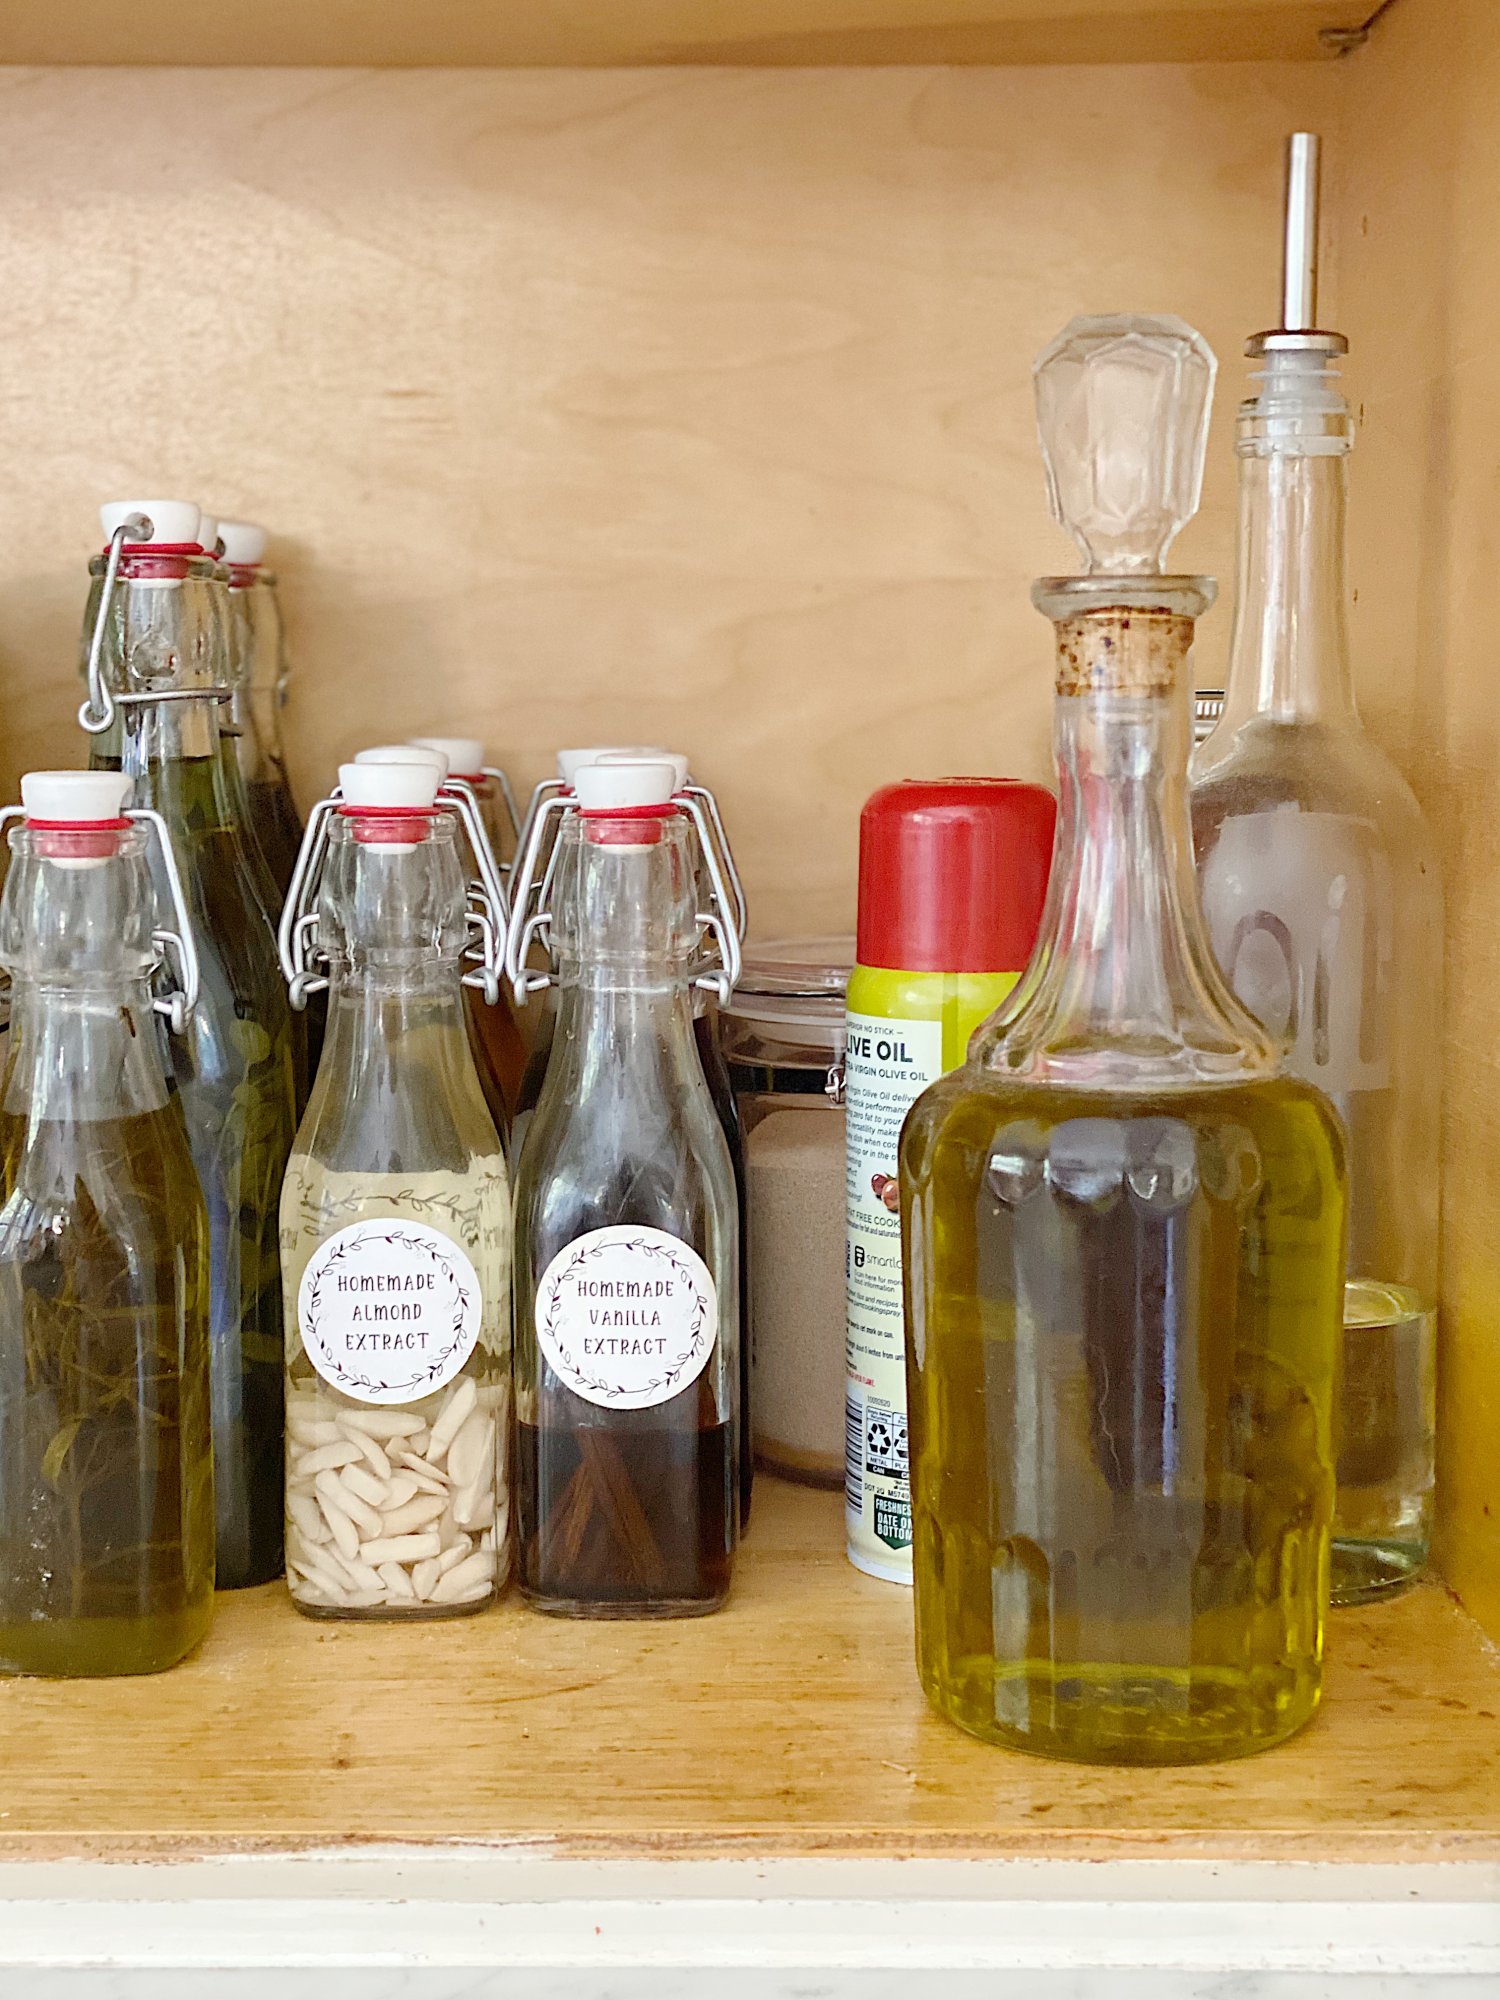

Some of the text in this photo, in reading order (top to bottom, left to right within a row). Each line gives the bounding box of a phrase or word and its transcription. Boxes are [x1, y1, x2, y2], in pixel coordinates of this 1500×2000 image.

[874, 1027, 894, 1035] STICK
[877, 1040, 913, 1063] OIL
[854, 1063, 877, 1076] VIRGIN
[879, 1068, 907, 1080] OLIVE
[909, 1072, 928, 1081] OIL
[862, 1088, 877, 1099] Olive
[880, 1091, 890, 1101] Oil
[865, 1102, 907, 1114] performanc
[883, 1117, 901, 1125] your
[864, 1139, 881, 1147] when
[870, 1149, 876, 1157] in
[877, 1151, 889, 1160] the
[856, 1211, 873, 1224] FREE
[338, 1274, 435, 1291] HOMEMADE
[865, 1273, 876, 1281] here
[577, 1280, 674, 1297] HOMEMADE
[864, 1281, 895, 1292] information
[865, 1295, 875, 1303] and
[876, 1299, 898, 1308] recipes
[352, 1303, 422, 1321] ALMOND
[590, 1309, 661, 1326] VANILLA
[346, 1332, 429, 1350] EXTRACT
[584, 1338, 667, 1354] EXTRACT
[883, 1350, 894, 1359] from
[870, 1457, 888, 1466] METAL
[873, 1466, 885, 1474] CAN
[864, 1483, 875, 1491] DOT
[877, 1512, 898, 1526] DATE
[877, 1523, 913, 1540] BOTTOM
